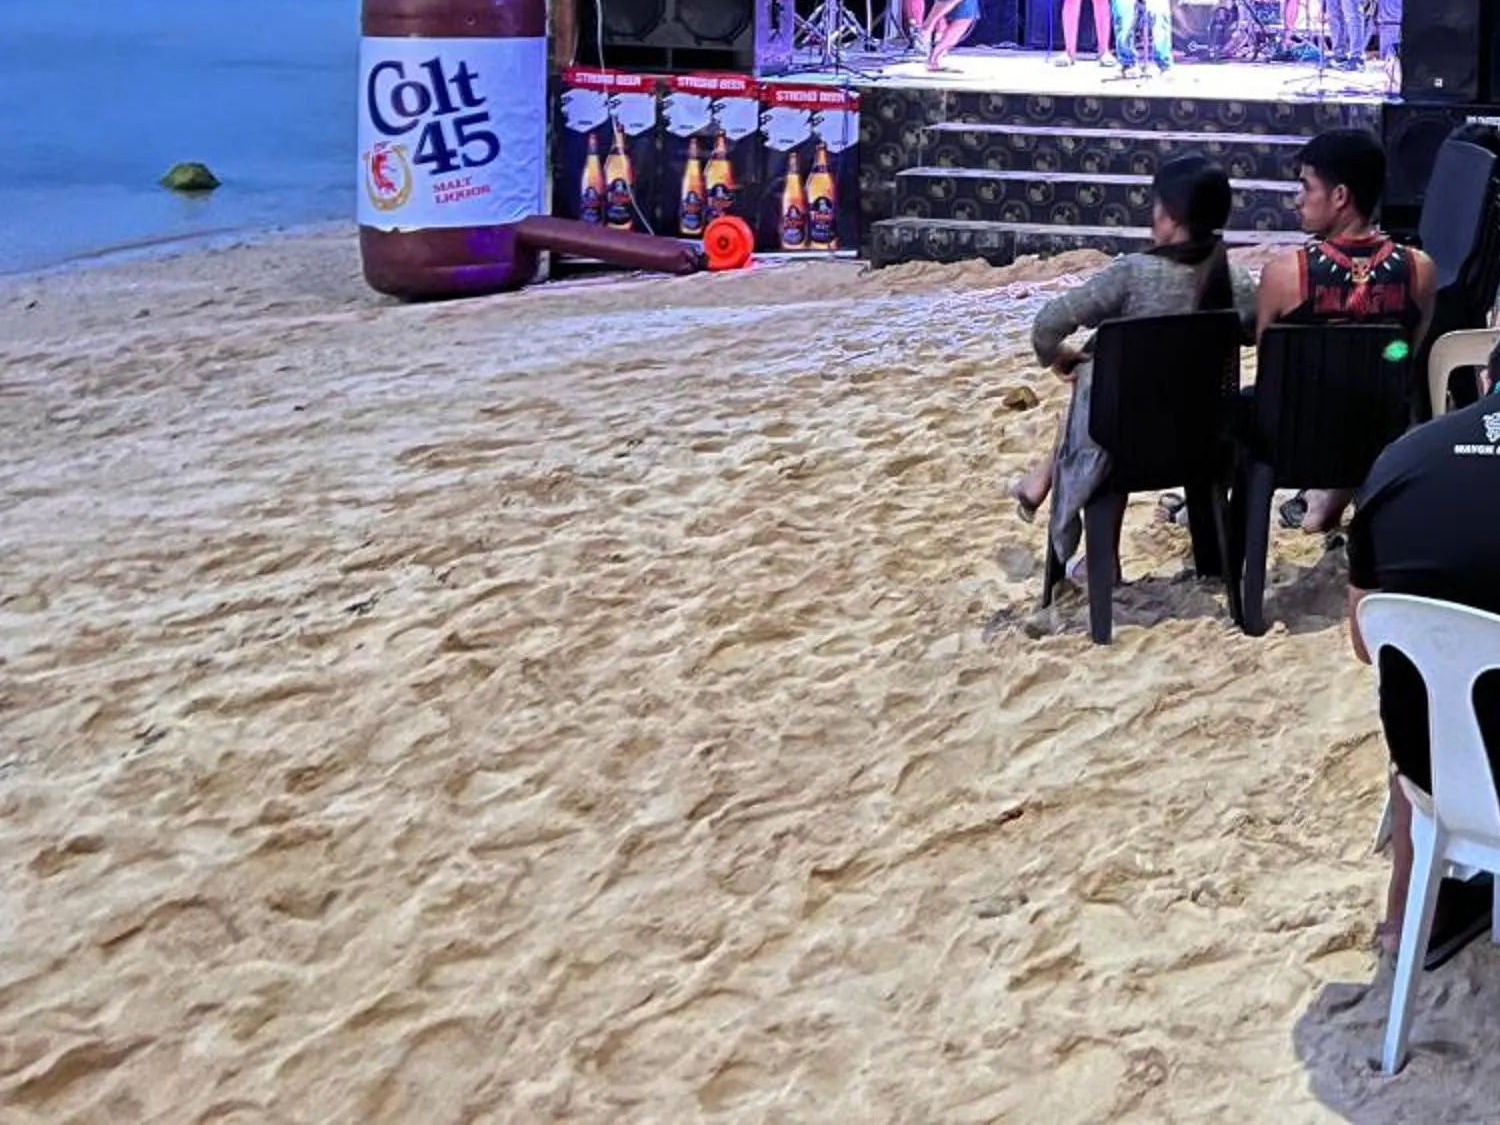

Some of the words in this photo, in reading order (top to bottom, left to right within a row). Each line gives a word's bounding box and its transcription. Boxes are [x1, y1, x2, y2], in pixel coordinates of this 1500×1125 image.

[367, 56, 487, 136] Colt
[412, 111, 501, 176] 45
[432, 176, 473, 193] MALT
[435, 184, 492, 204] LIQUOR
